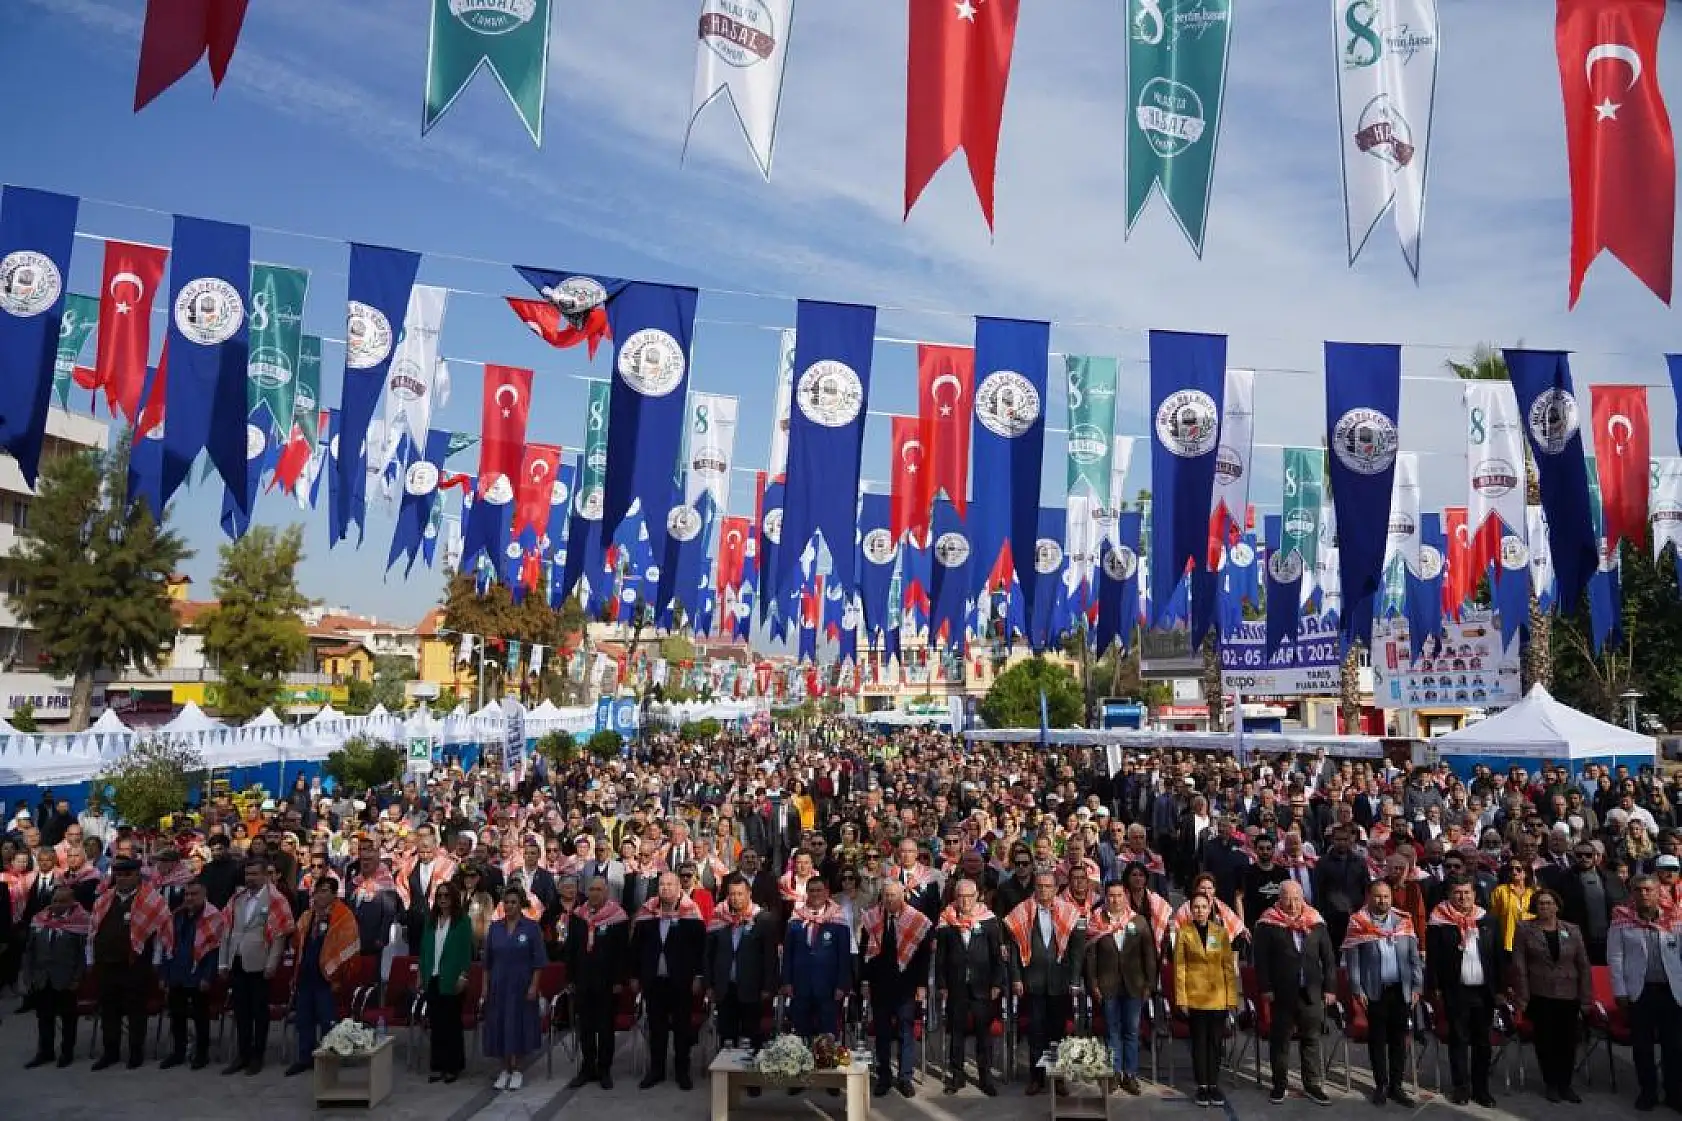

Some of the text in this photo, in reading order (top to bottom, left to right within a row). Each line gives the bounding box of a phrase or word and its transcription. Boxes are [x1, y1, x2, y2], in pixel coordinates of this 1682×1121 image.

[1345, 1, 1381, 68] 8
[253, 292, 269, 331] 8
[694, 404, 708, 434] 8
[1470, 407, 1485, 445] 8
